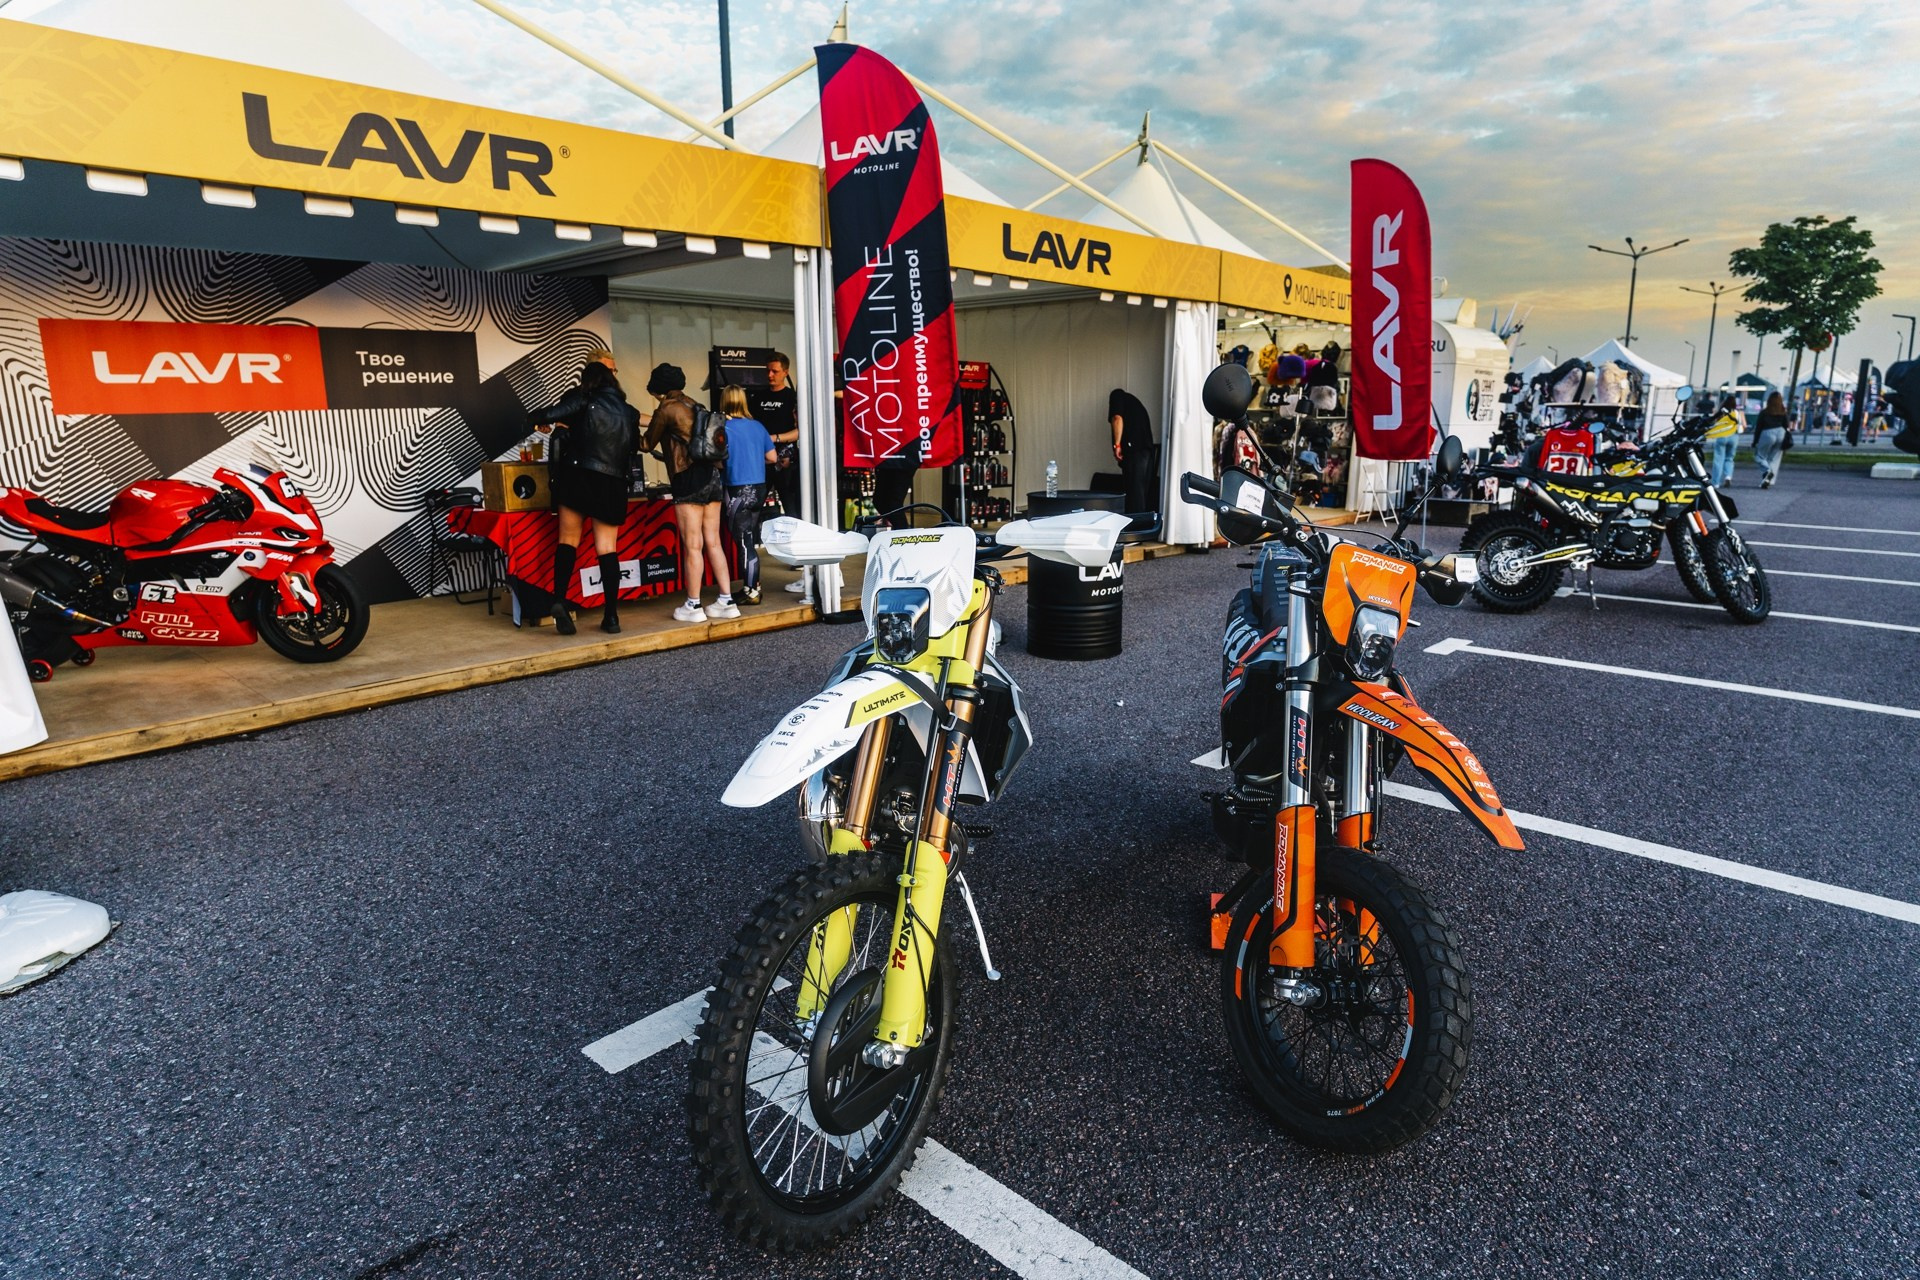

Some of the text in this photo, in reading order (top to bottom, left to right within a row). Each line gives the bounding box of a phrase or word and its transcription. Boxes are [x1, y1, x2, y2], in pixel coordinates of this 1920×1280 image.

[242, 92, 556, 196] LAVR
[830, 128, 918, 162] LAVR
[853, 162, 900, 175] MOTOLINE
[1002, 222, 1112, 275] LAVR
[1295, 284, 1335, 309] МОДНЫЕ
[1373, 209, 1404, 431] LAVR
[356, 351, 405, 367] Твое
[720, 350, 746, 358] LAVR
[864, 244, 906, 460] MOTOLINE
[905, 249, 933, 463] Твое преимущество!
[92, 351, 283, 384] LAVR
[362, 370, 454, 387] решение
[959, 364, 980, 372] LAVR
[843, 357, 876, 460] LAVR
[1551, 457, 1579, 475] 28
[888, 534, 944, 548] ROMANIAC
[1351, 551, 1407, 575] ROMANIAC
[589, 569, 631, 586] LR
[140, 611, 194, 627] FULL
[151, 626, 219, 641] GAZZZ
[863, 691, 907, 713] ULTIMATE
[1275, 823, 1288, 913] ROMANIAC
